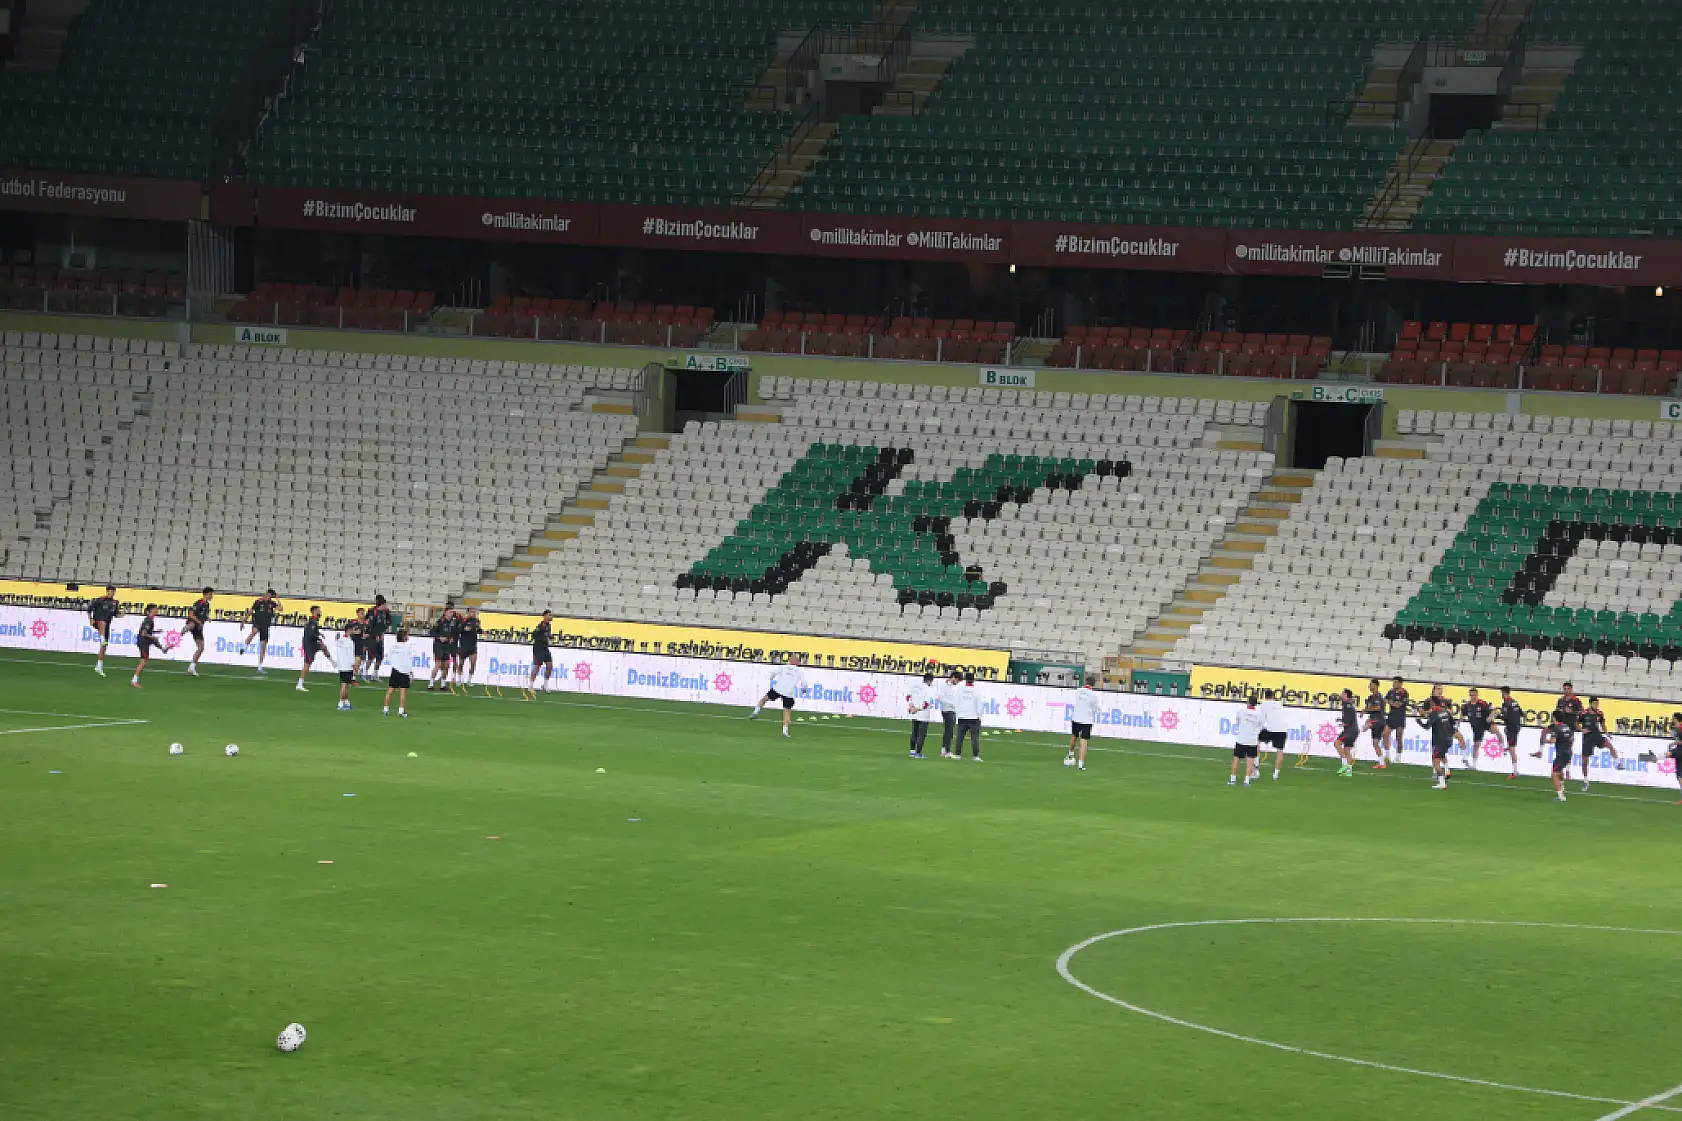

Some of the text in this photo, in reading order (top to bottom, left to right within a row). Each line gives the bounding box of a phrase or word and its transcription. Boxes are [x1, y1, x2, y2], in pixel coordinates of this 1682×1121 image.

[0, 177, 126, 204] utbol Federasyonu
[302, 199, 417, 222] #BizimÇocuklar
[642, 217, 759, 240] #BizimÇocuklar
[1055, 234, 1179, 258] #BizimÇocuklar
[1504, 247, 1642, 271] #BizimÇocuklar
[241, 328, 280, 343] A BLOK
[987, 370, 1027, 385] B BLOK
[1668, 403, 1681, 417] C
[677, 443, 1131, 610] K
[628, 668, 708, 691] DenizBank
